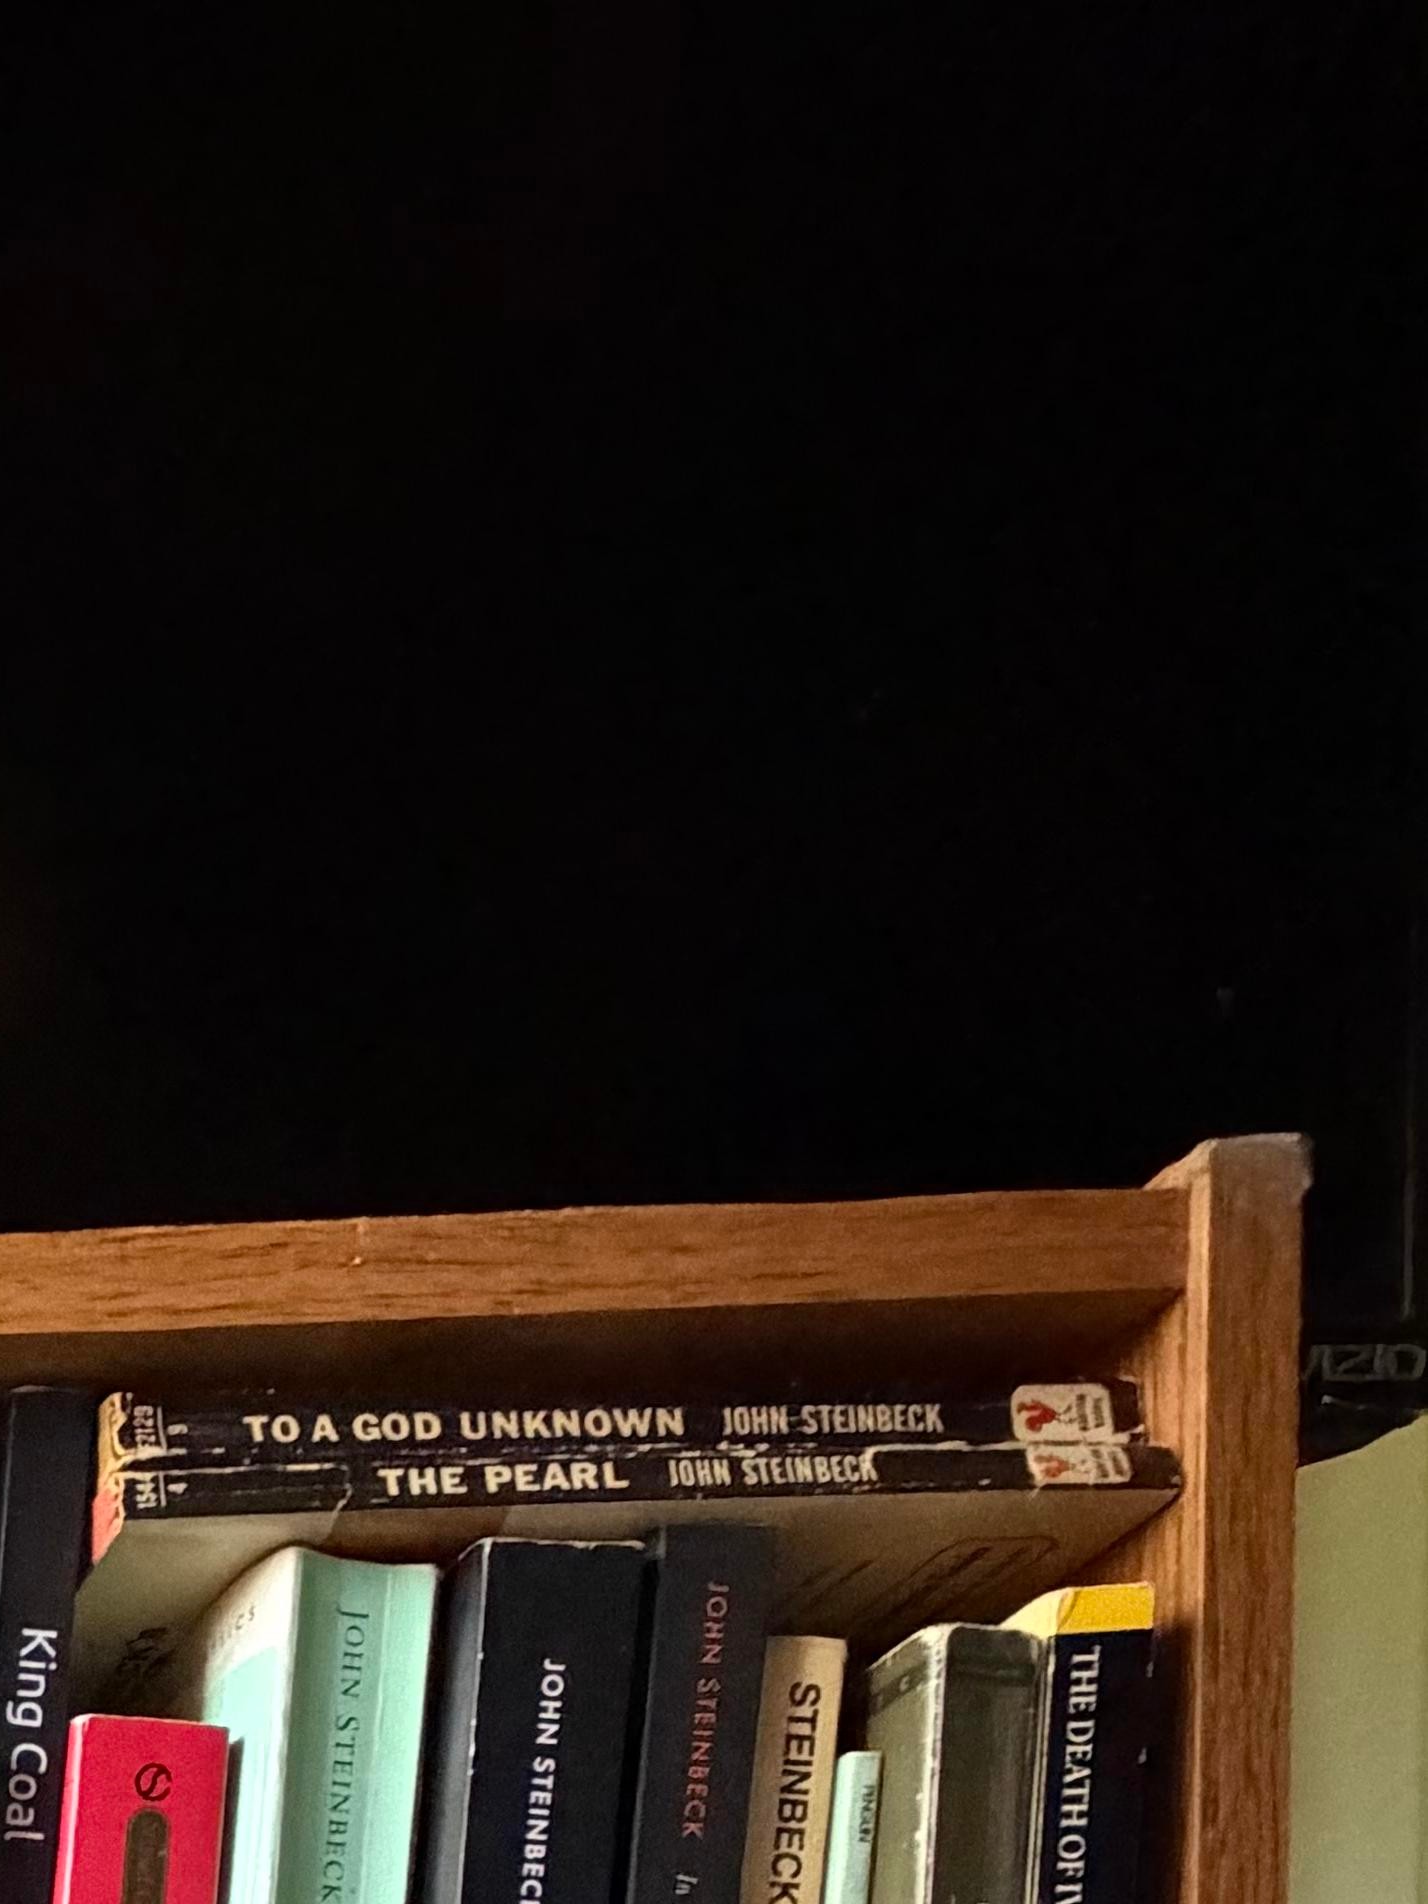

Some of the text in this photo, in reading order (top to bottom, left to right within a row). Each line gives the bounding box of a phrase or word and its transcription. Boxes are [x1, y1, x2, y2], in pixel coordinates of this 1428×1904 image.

[243, 1403, 945, 1443] TO A GOD UNKNOWN JOHN STEINBECK
[379, 1452, 877, 1494] THE PEARL JOHN STEINBECK
[538, 1659, 565, 1742] JOHN
[3, 1627, 58, 1843] King Coal
